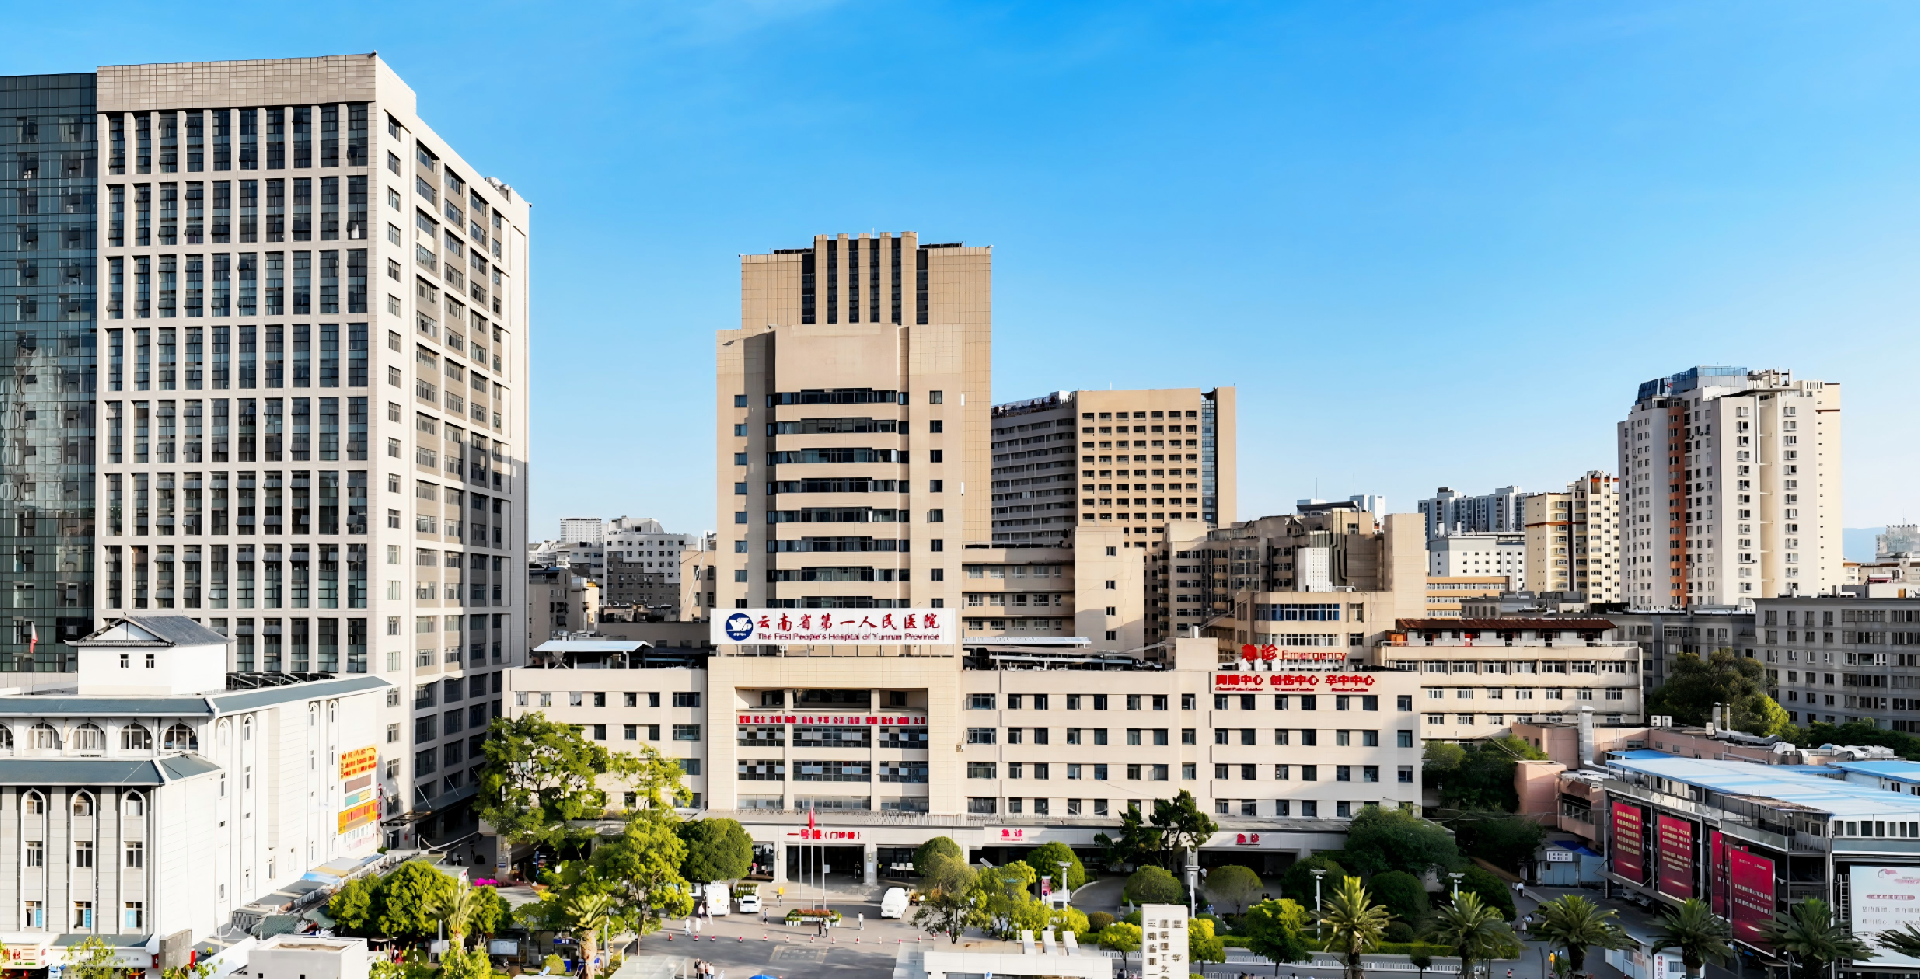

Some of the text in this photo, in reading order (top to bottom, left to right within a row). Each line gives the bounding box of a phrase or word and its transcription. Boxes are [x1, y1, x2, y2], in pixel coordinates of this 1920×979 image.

[757, 612, 940, 632] 云南省第一人民医院
[757, 632, 772, 641] The
[774, 632, 792, 641] First
[793, 632, 827, 642] People's
[862, 632, 871, 641] of
[904, 632, 940, 641] Province
[1281, 650, 1348, 662] Emergency
[1215, 674, 1264, 686] 中心
[1325, 674, 1375, 686] 卒中中心
